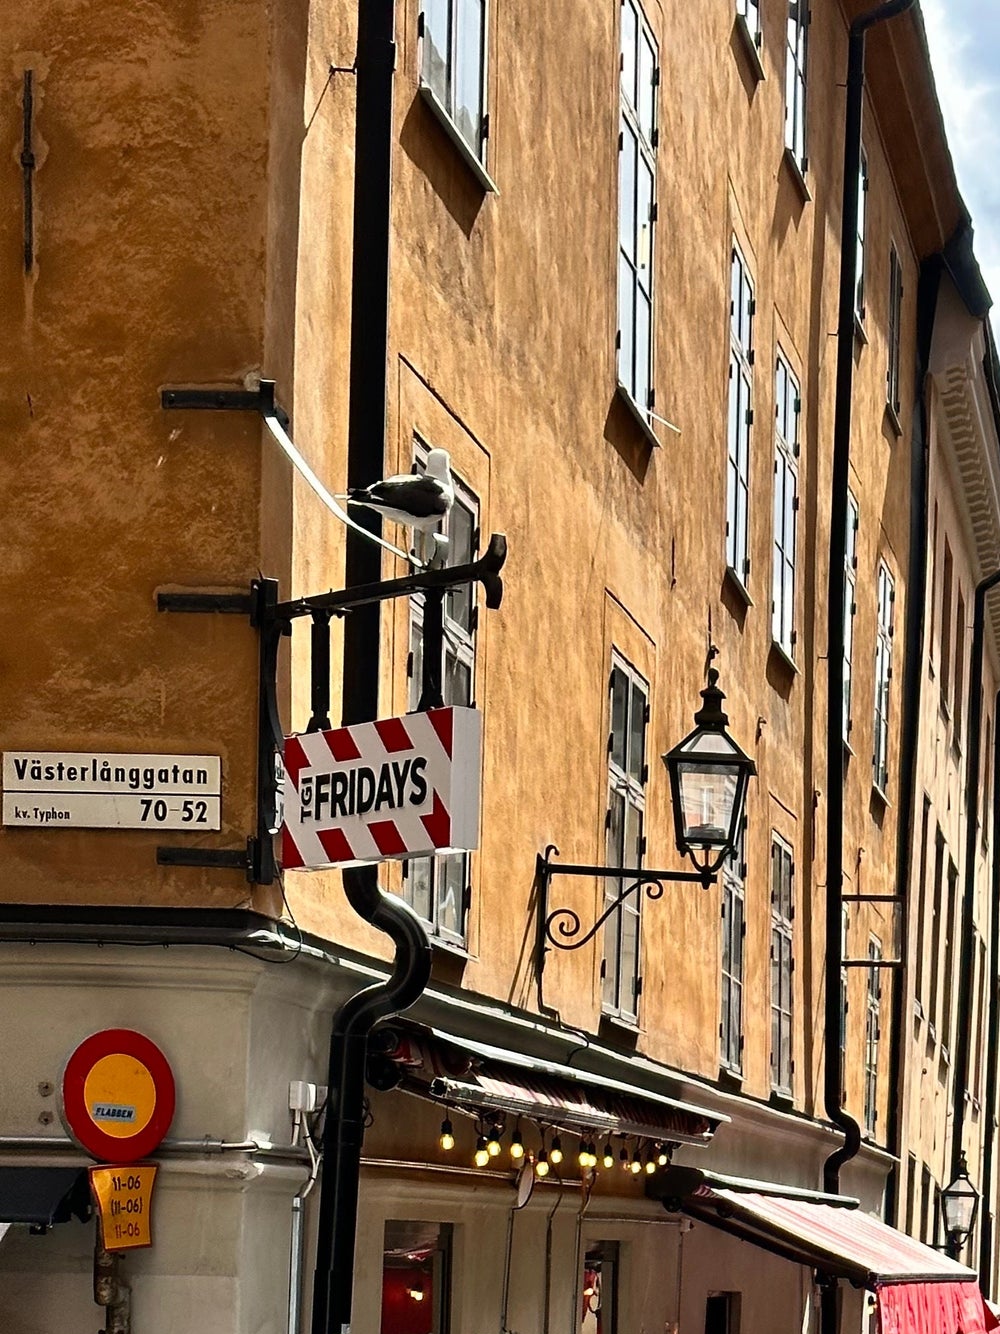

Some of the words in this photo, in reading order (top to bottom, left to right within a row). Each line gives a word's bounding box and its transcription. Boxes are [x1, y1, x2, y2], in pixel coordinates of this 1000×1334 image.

[14, 758, 208, 789] Västerlånggatan
[314, 756, 428, 821] FRIDAYS
[300, 776, 313, 824] TGI
[14, 806, 31, 819] kv.
[33, 807, 70, 822] Typhon
[112, 1175, 141, 1191] 11-06
[110, 1196, 143, 1216] (11-06)
[114, 1222, 141, 1239] 11-06
